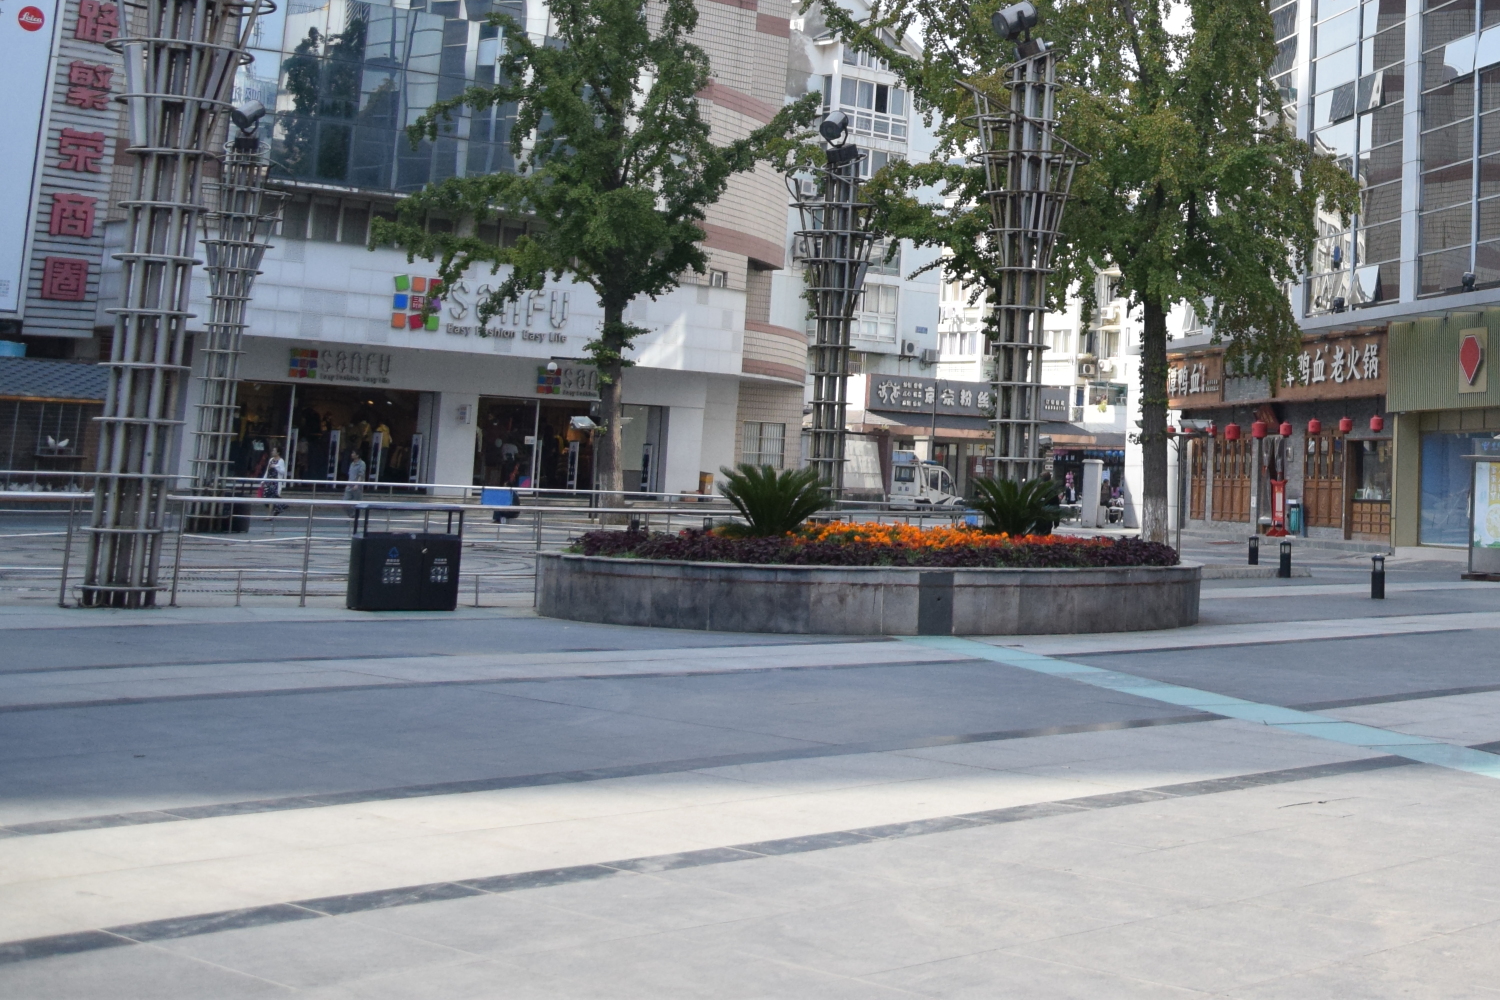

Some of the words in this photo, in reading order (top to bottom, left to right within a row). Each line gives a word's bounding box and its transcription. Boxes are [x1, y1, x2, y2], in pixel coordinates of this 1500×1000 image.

[446, 323, 471, 337] Easy
[474, 325, 515, 339] Fshion
[521, 329, 545, 343] Easy
[548, 332, 567, 344] Life
